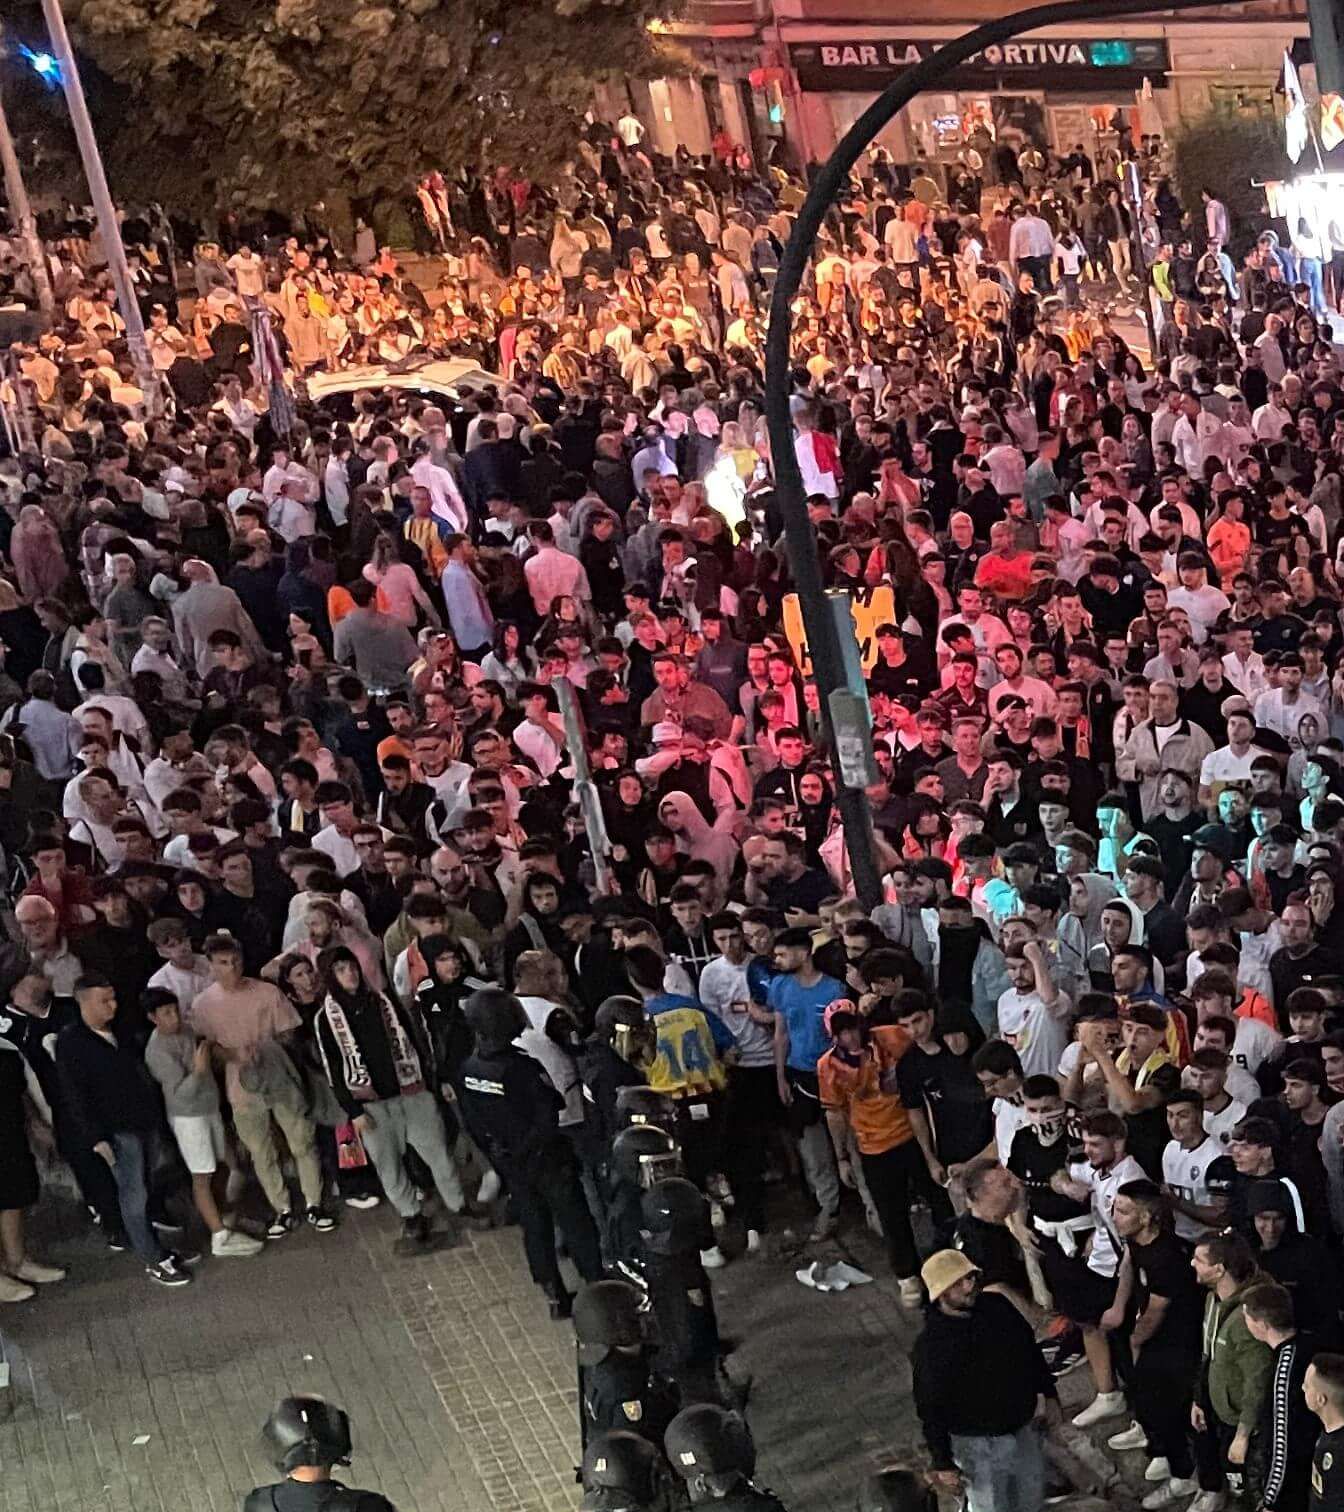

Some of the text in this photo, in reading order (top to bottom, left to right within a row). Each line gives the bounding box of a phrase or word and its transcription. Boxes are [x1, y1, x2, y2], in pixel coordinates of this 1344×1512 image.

[821, 43, 1086, 66] BAR LA ORTIVA
